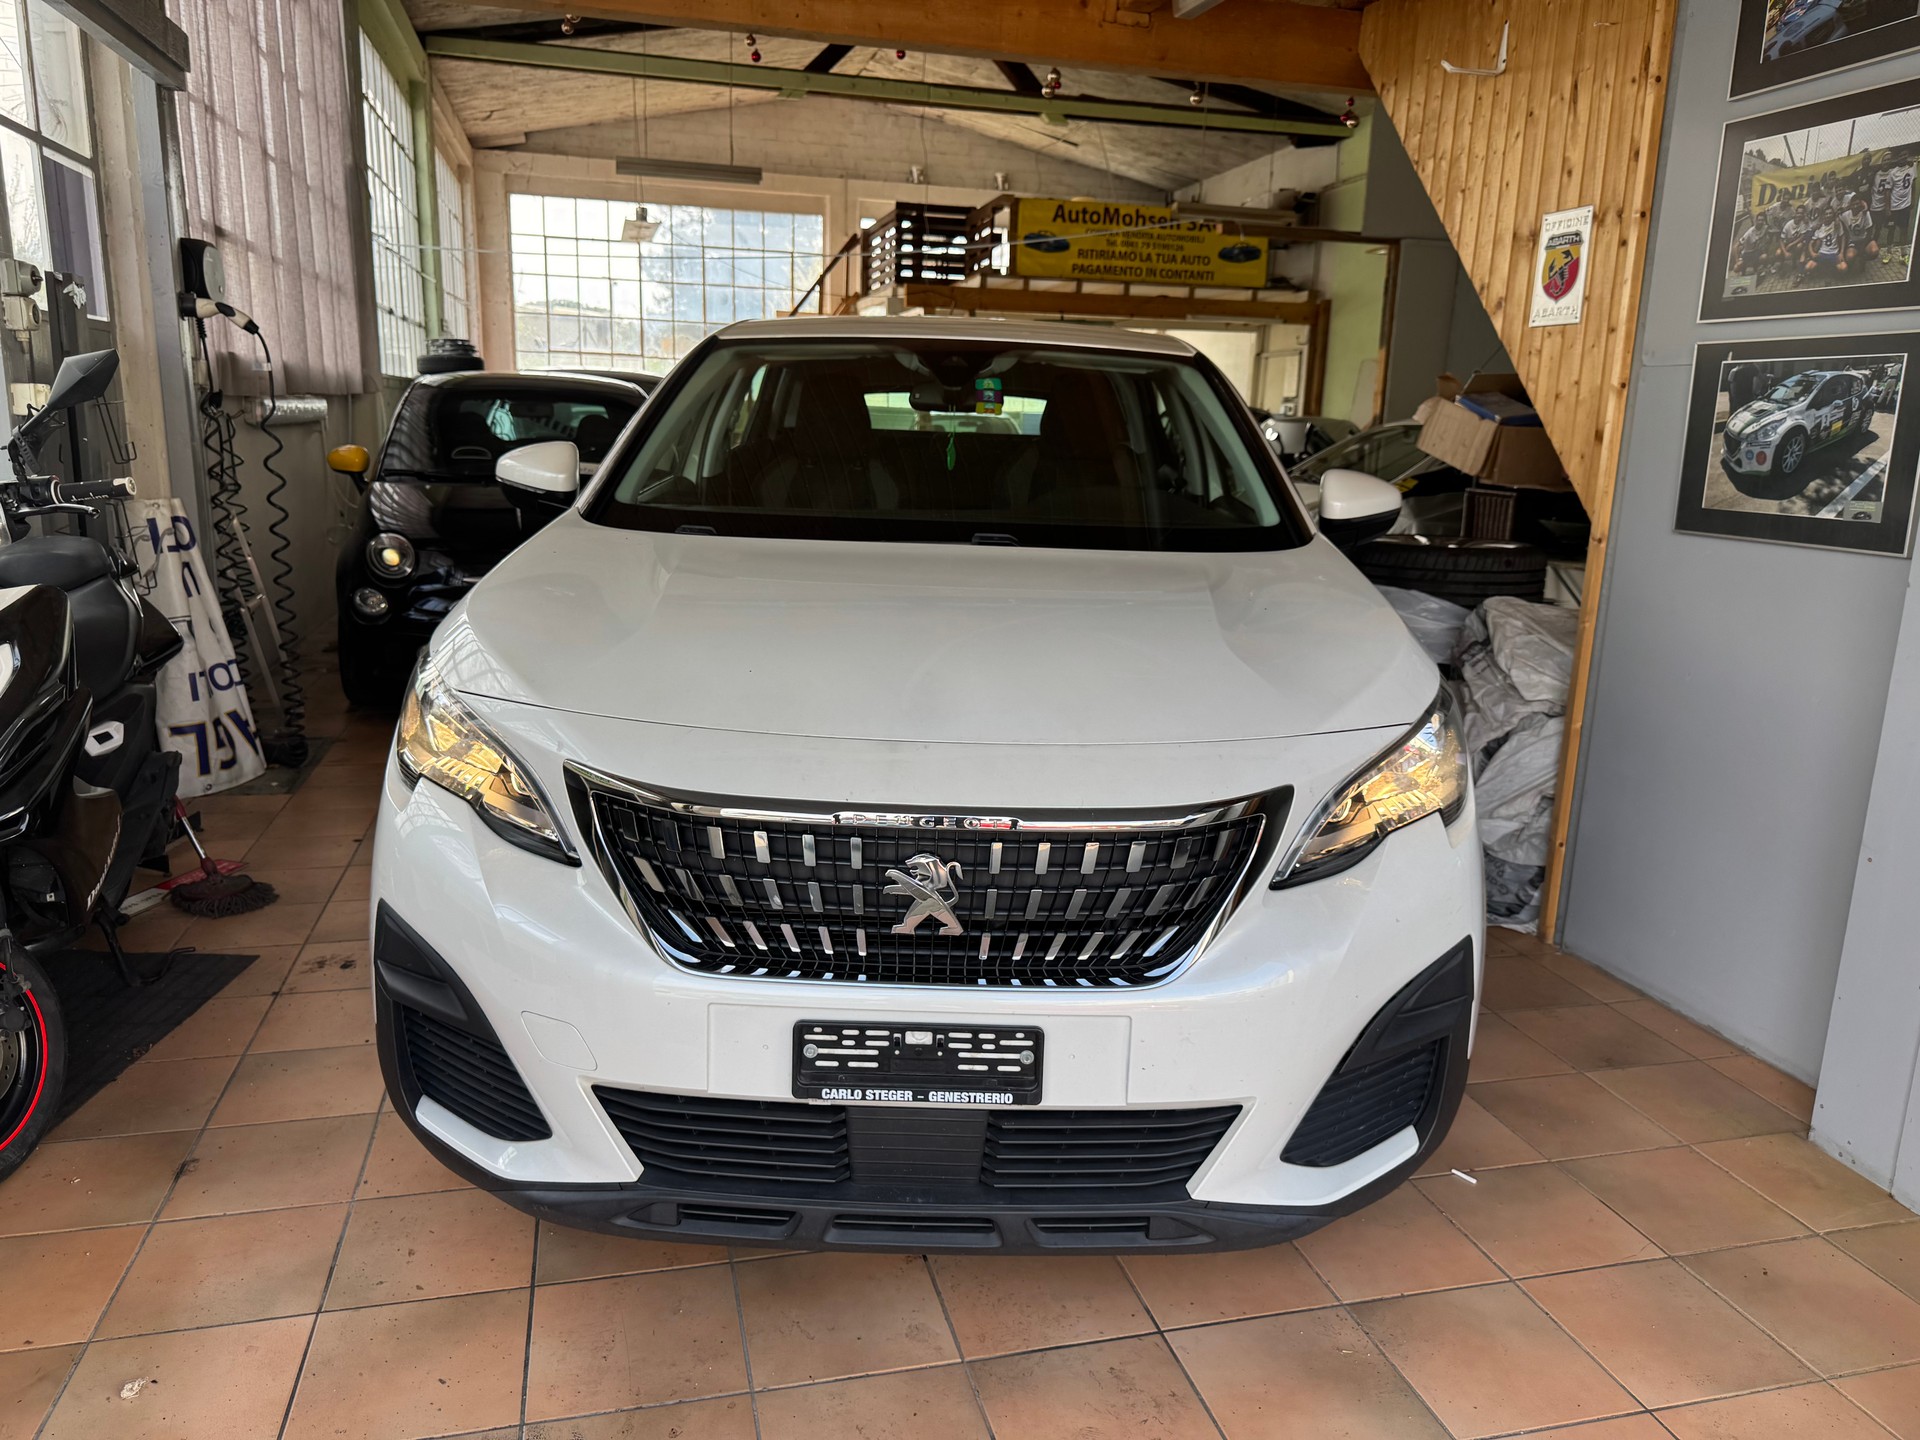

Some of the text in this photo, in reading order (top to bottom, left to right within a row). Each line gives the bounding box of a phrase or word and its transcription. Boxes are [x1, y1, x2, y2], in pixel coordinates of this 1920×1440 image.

[1548, 235, 1580, 246] ABARTH
[1078, 249, 1211, 267] RITIRIAMO LA TUA AUTO
[1072, 264, 1215, 281] PAGAMENTO IN CONTANTI
[853, 814, 1003, 829] PEUGEOT
[821, 1088, 863, 1100] CARLO
[865, 1089, 913, 1101] STEGER
[928, 1091, 1014, 1104] GENESTRERIO
